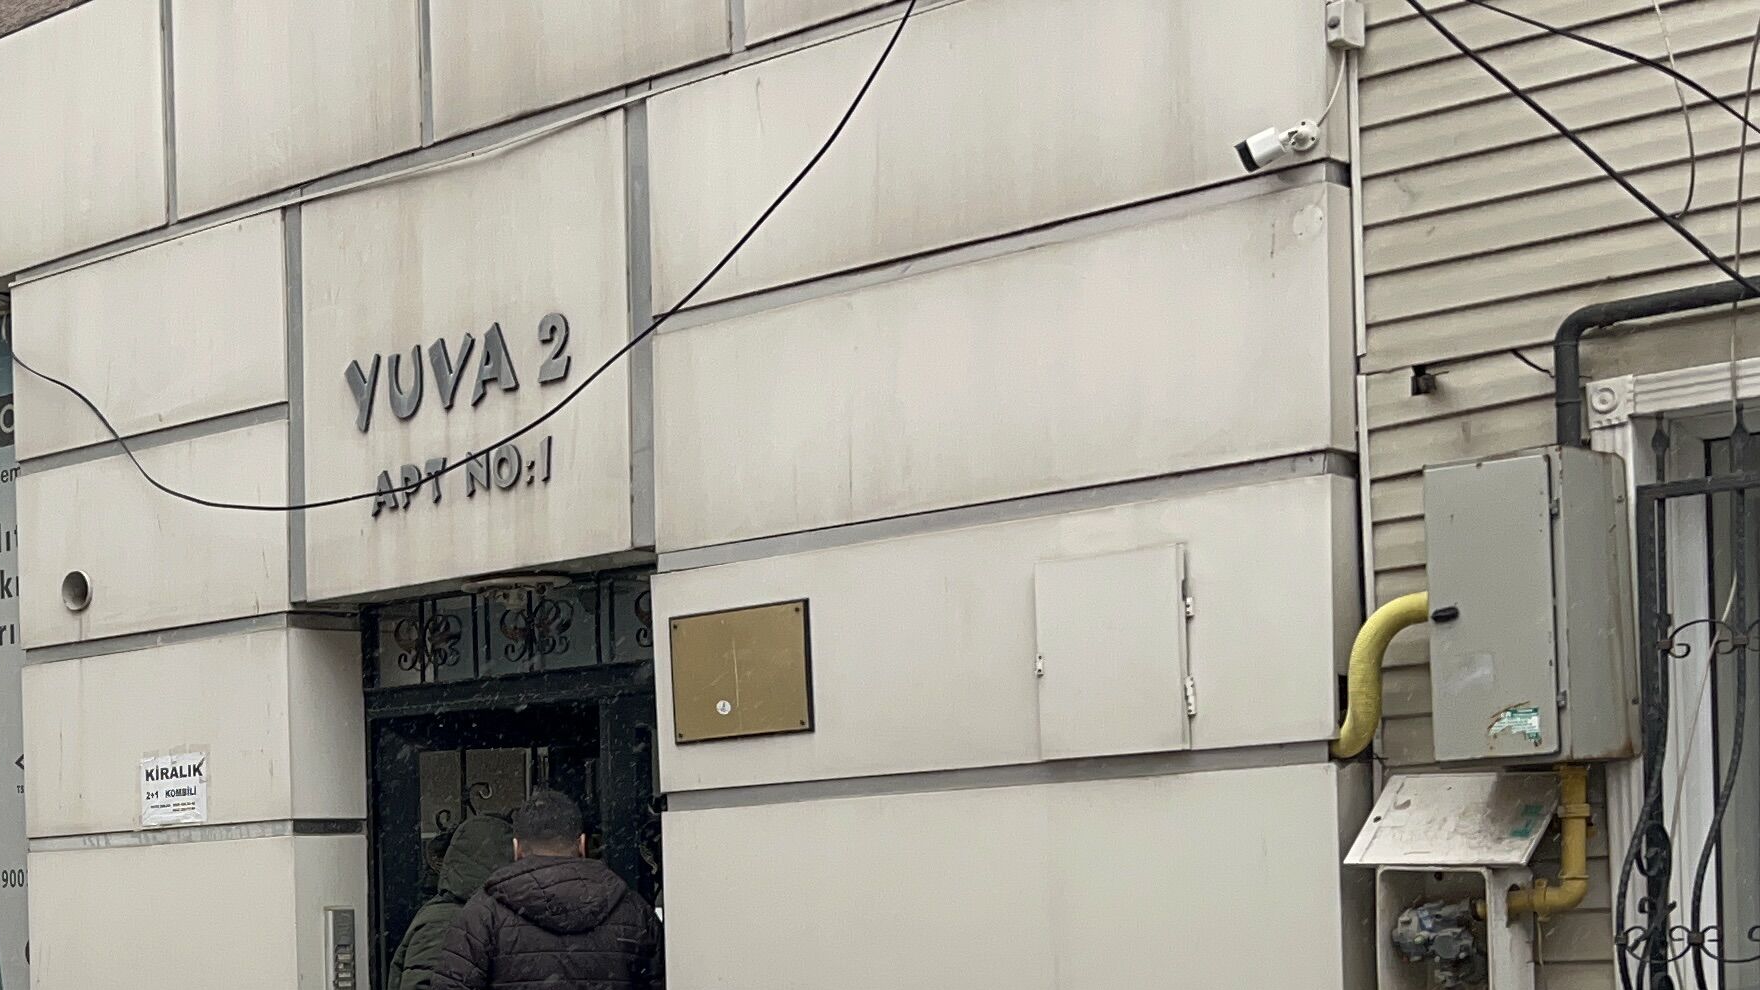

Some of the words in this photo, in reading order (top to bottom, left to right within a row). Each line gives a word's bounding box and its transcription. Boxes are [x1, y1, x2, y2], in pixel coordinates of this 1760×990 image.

[344, 321, 520, 433] YUVA
[537, 312, 571, 386] 2
[371, 457, 447, 520] APT
[145, 762, 204, 782] KİRALIK
